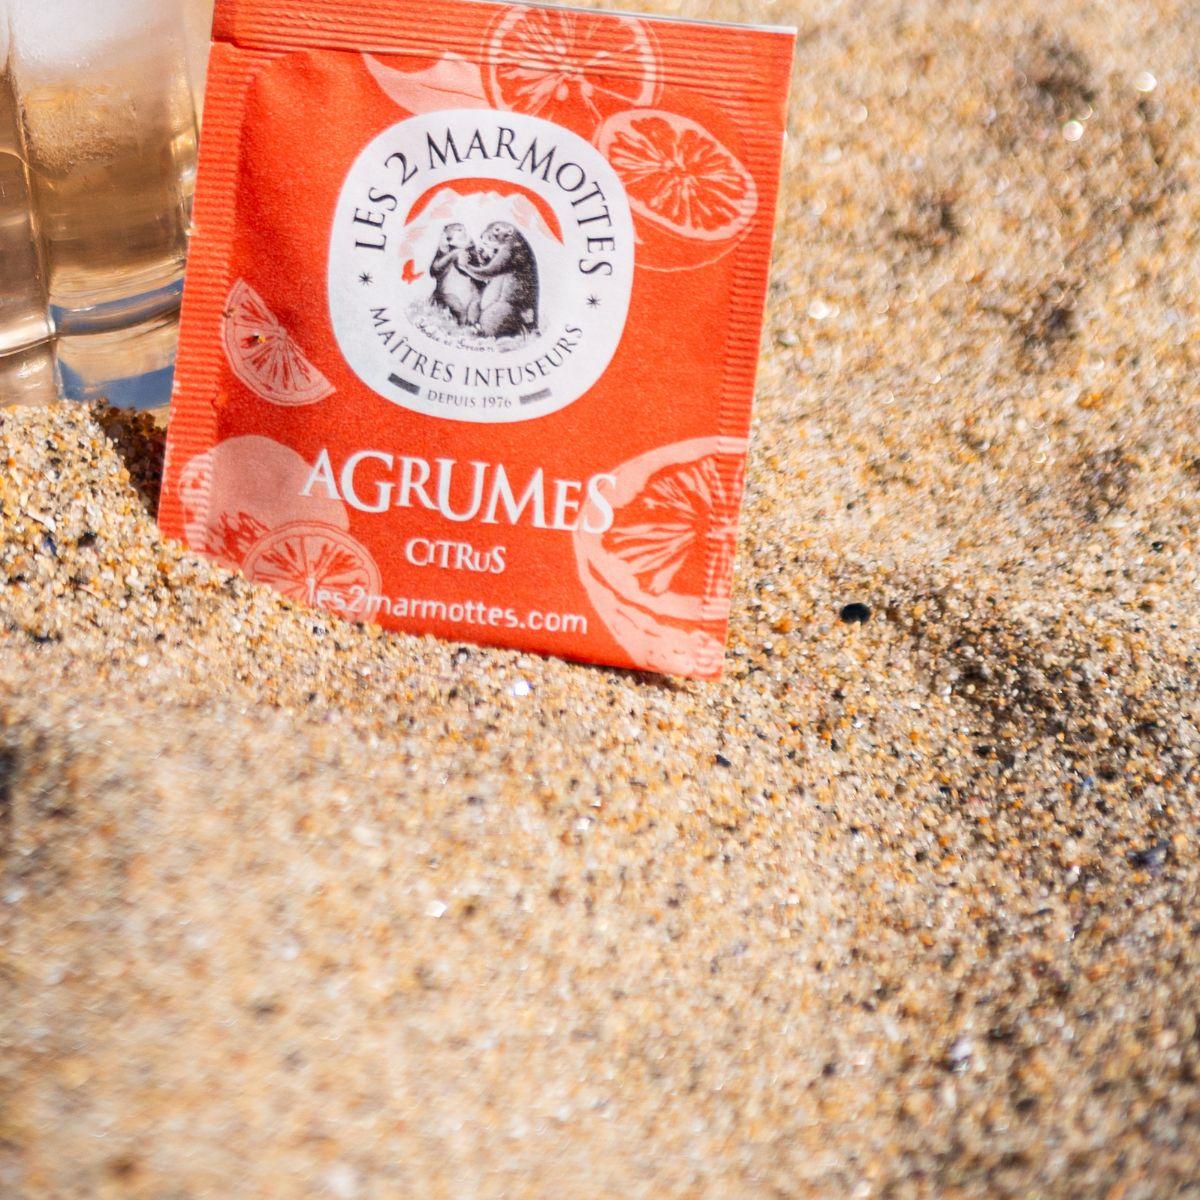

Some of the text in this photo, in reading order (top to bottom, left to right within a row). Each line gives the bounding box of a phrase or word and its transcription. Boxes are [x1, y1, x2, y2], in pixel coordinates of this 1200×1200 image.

[353, 126, 616, 277] LES 2 MARMOTTES
[370, 306, 455, 383] MAÎTRES
[464, 324, 583, 388] INFUSEURS
[427, 389, 512, 408] DEPUIS 1976
[300, 447, 617, 535] AGRUMES
[306, 577, 588, 634] les2marmottes.com
